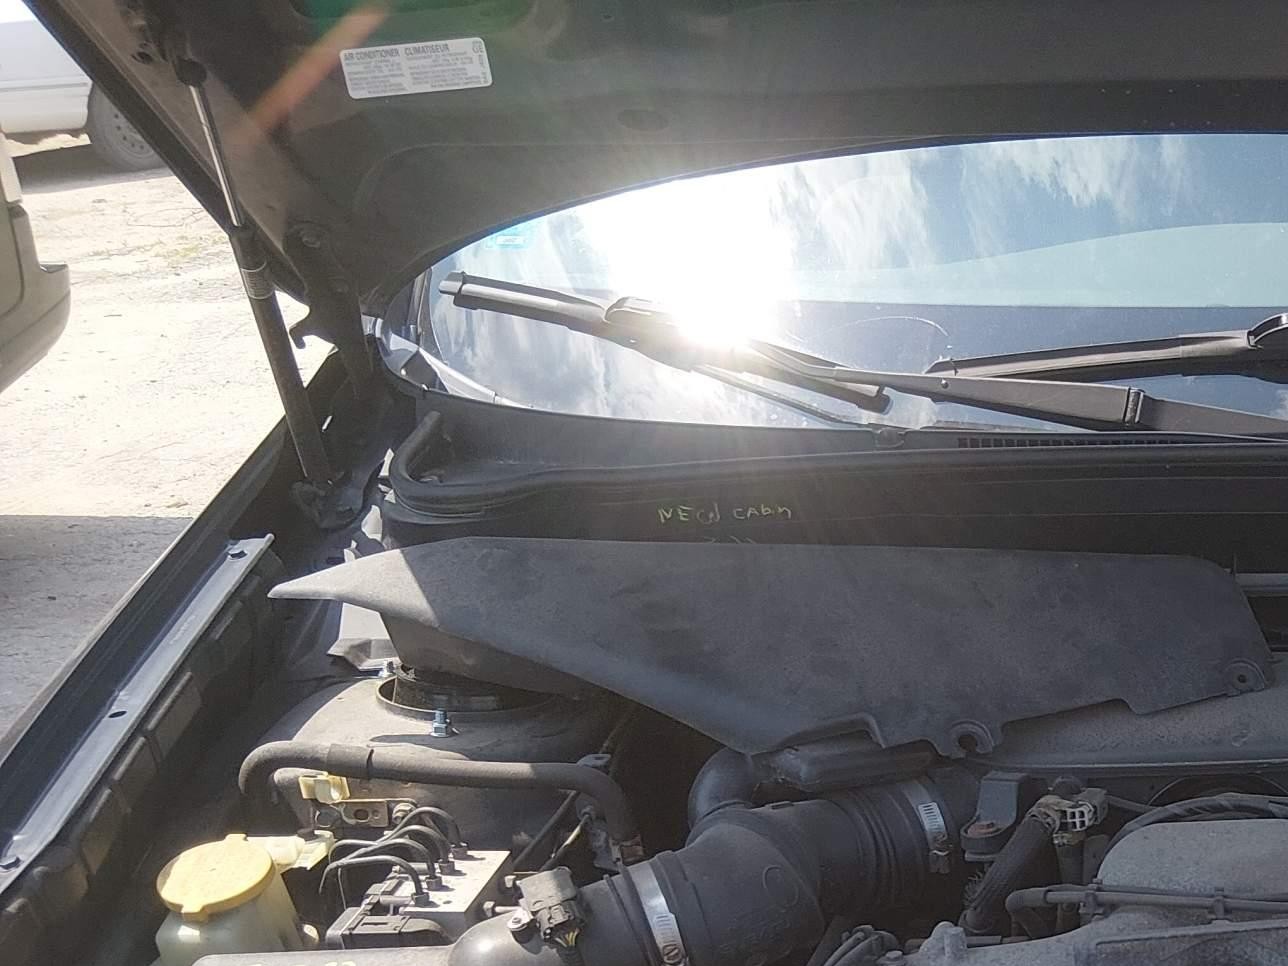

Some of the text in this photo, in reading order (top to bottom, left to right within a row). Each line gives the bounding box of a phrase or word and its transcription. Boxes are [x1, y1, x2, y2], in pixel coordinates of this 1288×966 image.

[343, 48, 401, 62] AIR CONDITIONER
[404, 43, 449, 57] CLIMATISEUR
